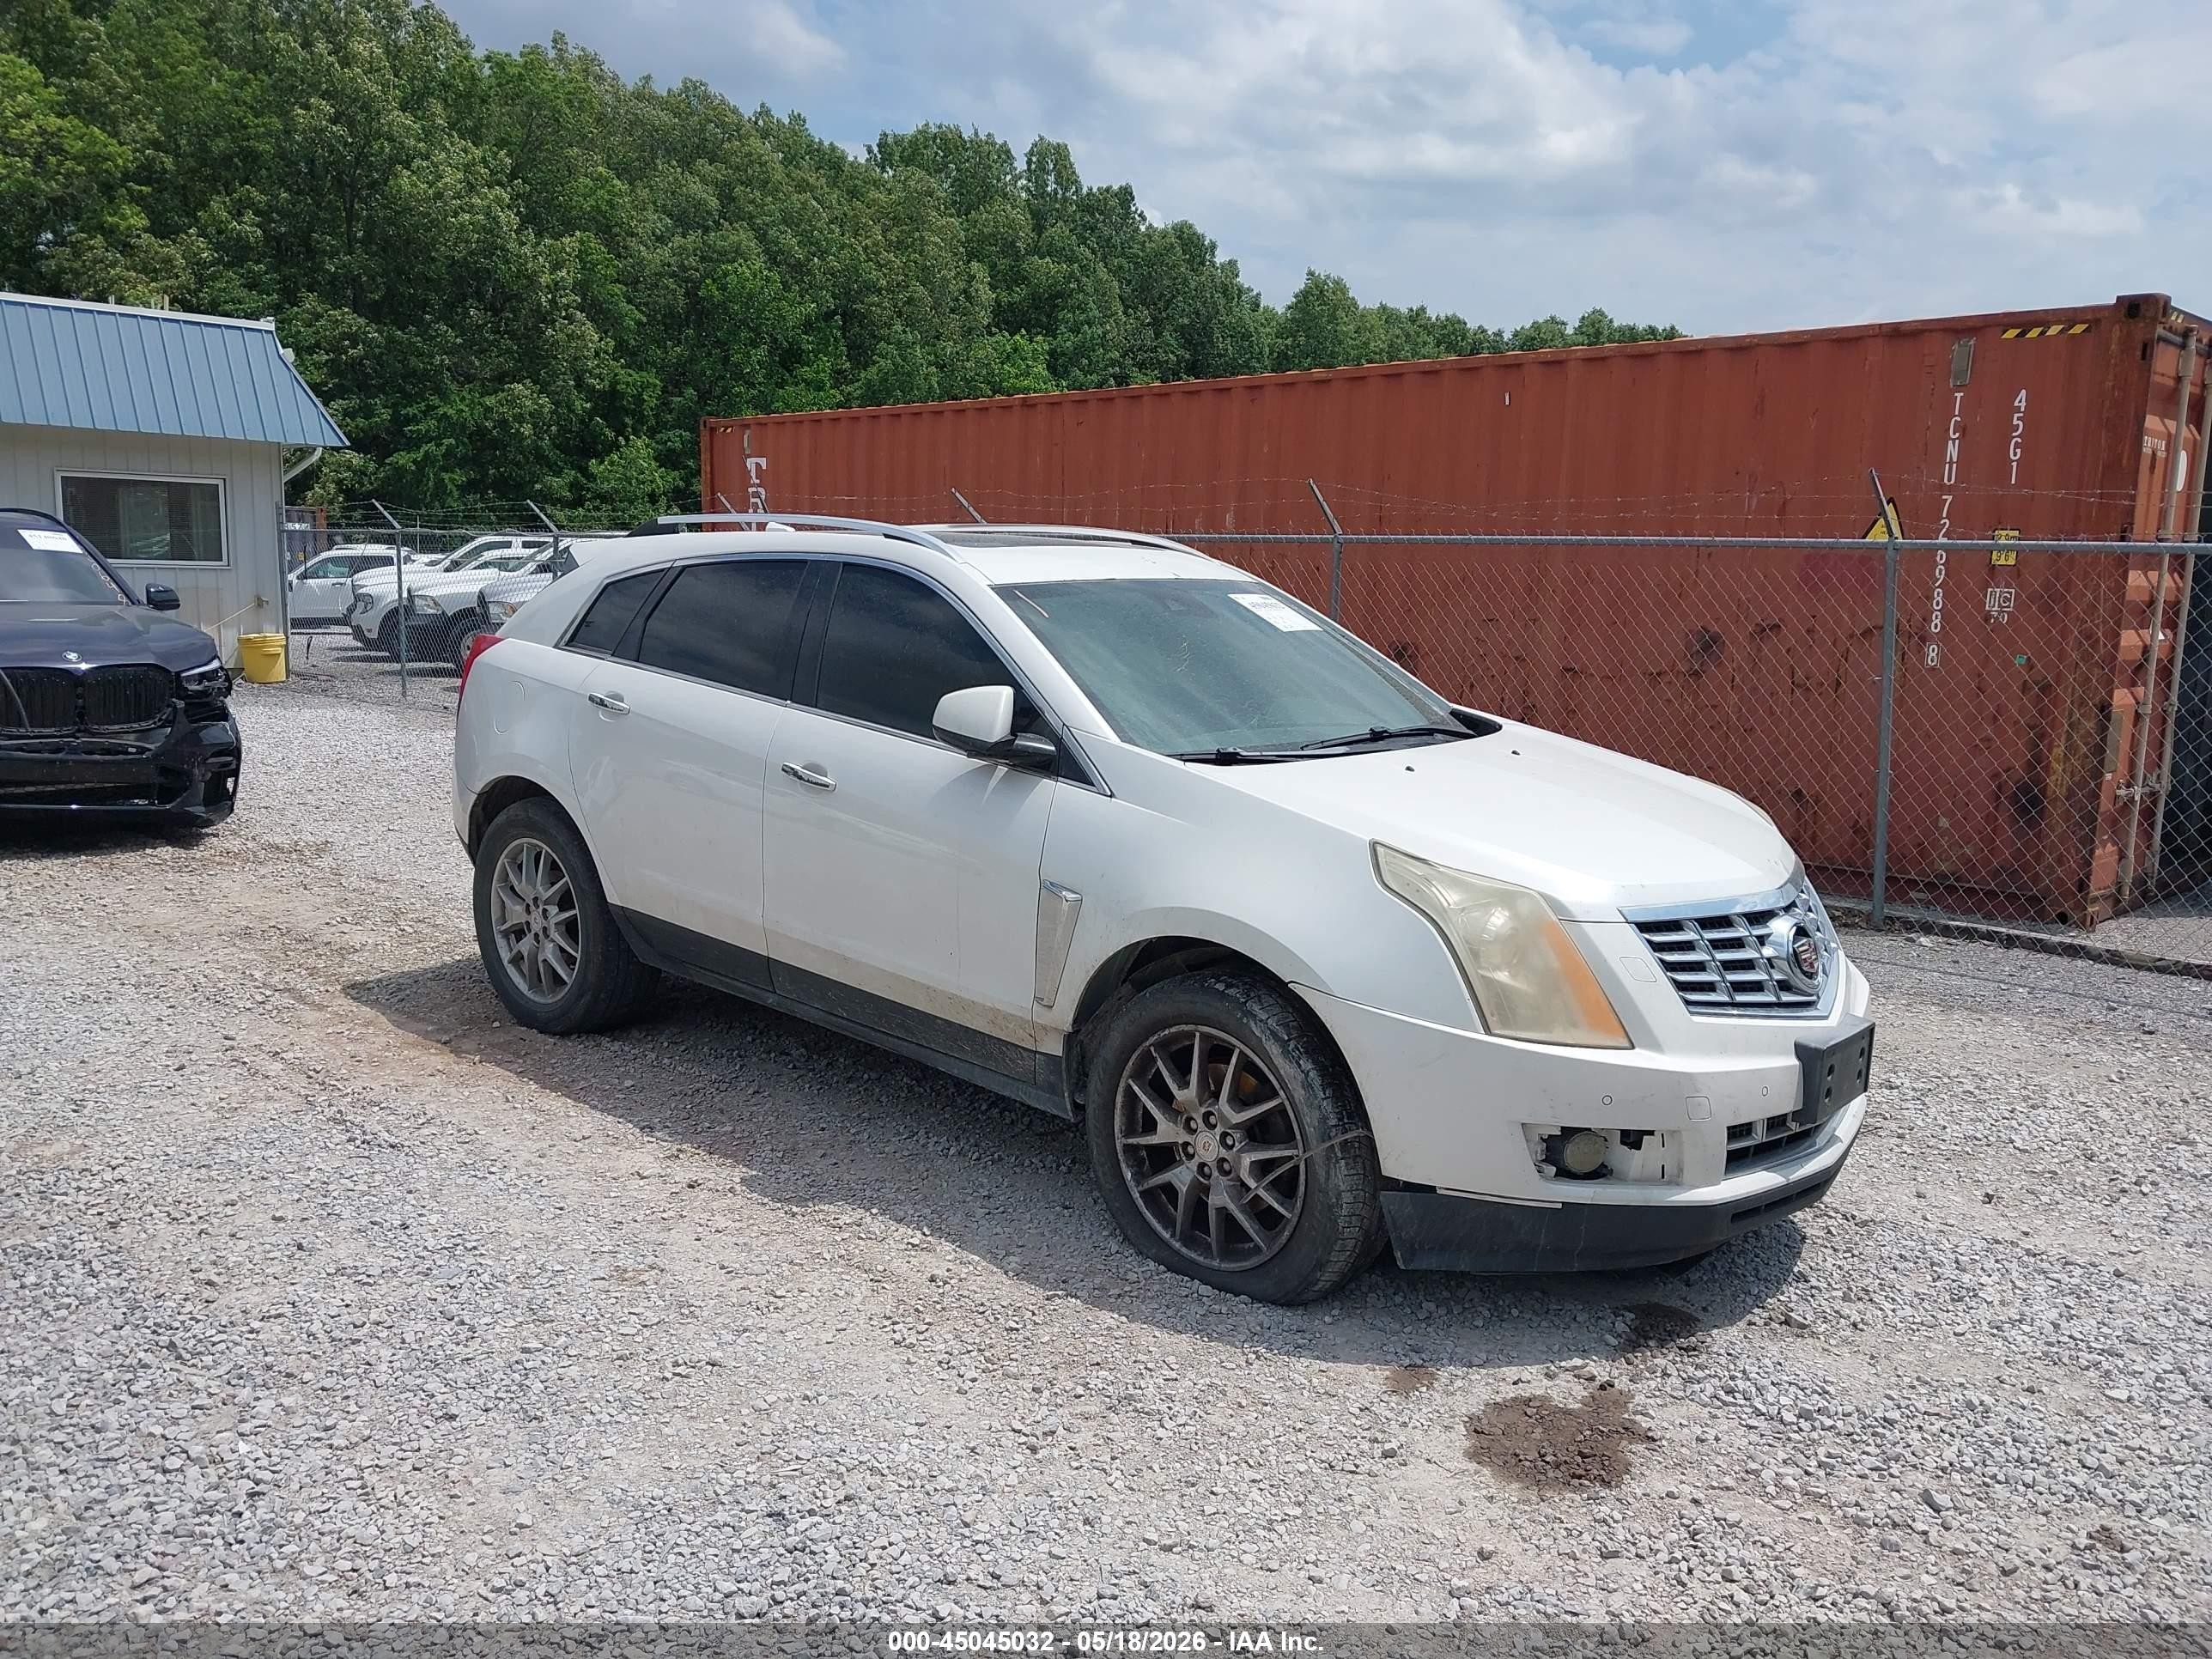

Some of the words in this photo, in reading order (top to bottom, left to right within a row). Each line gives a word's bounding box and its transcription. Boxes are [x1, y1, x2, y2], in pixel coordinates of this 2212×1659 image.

[1943, 392, 1964, 485] TCNU
[2009, 389, 2027, 484] 45G1
[746, 457, 767, 532] TR
[1926, 644, 1939, 666] 8
